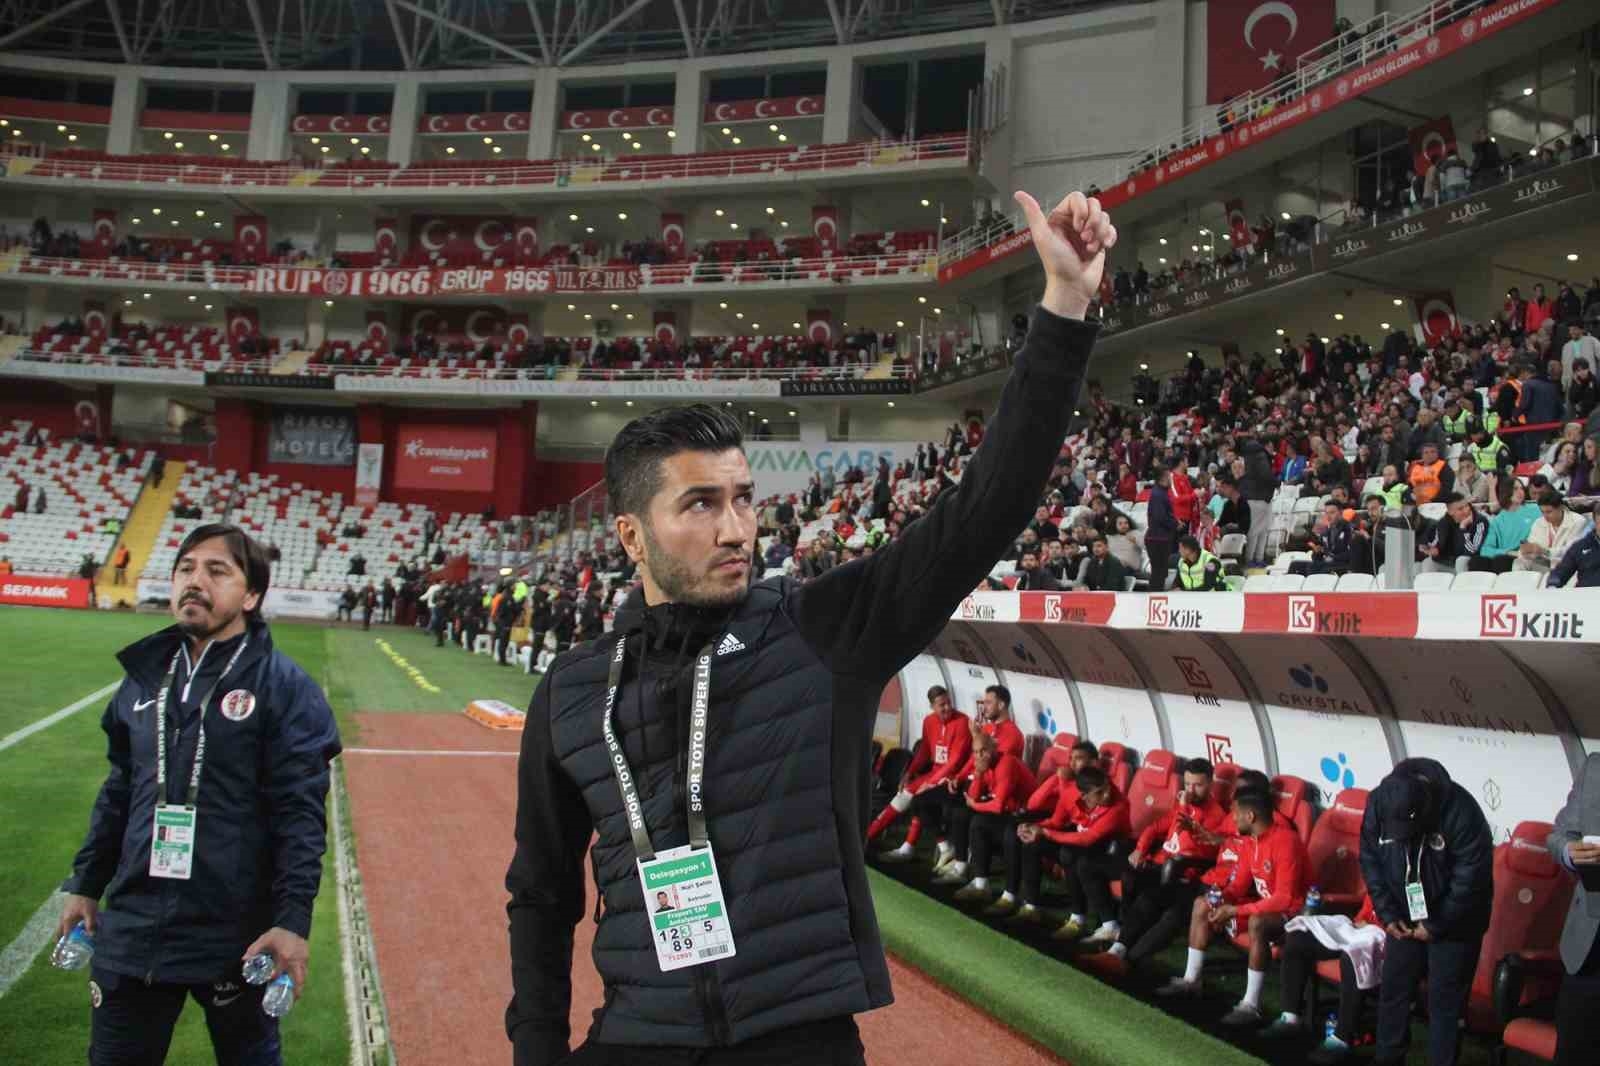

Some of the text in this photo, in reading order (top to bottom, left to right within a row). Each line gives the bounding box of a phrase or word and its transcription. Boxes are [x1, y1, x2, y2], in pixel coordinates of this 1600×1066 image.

[441, 268, 549, 291] GRUP 1966
[1169, 608, 1202, 628] Kilit
[1317, 611, 1362, 633] Kilit
[1521, 612, 1584, 639] Kilit
[1278, 692, 1364, 713] CRYSTAL
[1421, 708, 1537, 737] NIRVANA
[691, 731, 704, 769] TOTO
[614, 753, 631, 791] TOTO
[690, 773, 702, 812] SPOR
[626, 791, 642, 830] SPOR
[650, 863, 699, 881] Delegasyon
[703, 920, 713, 932] 5
